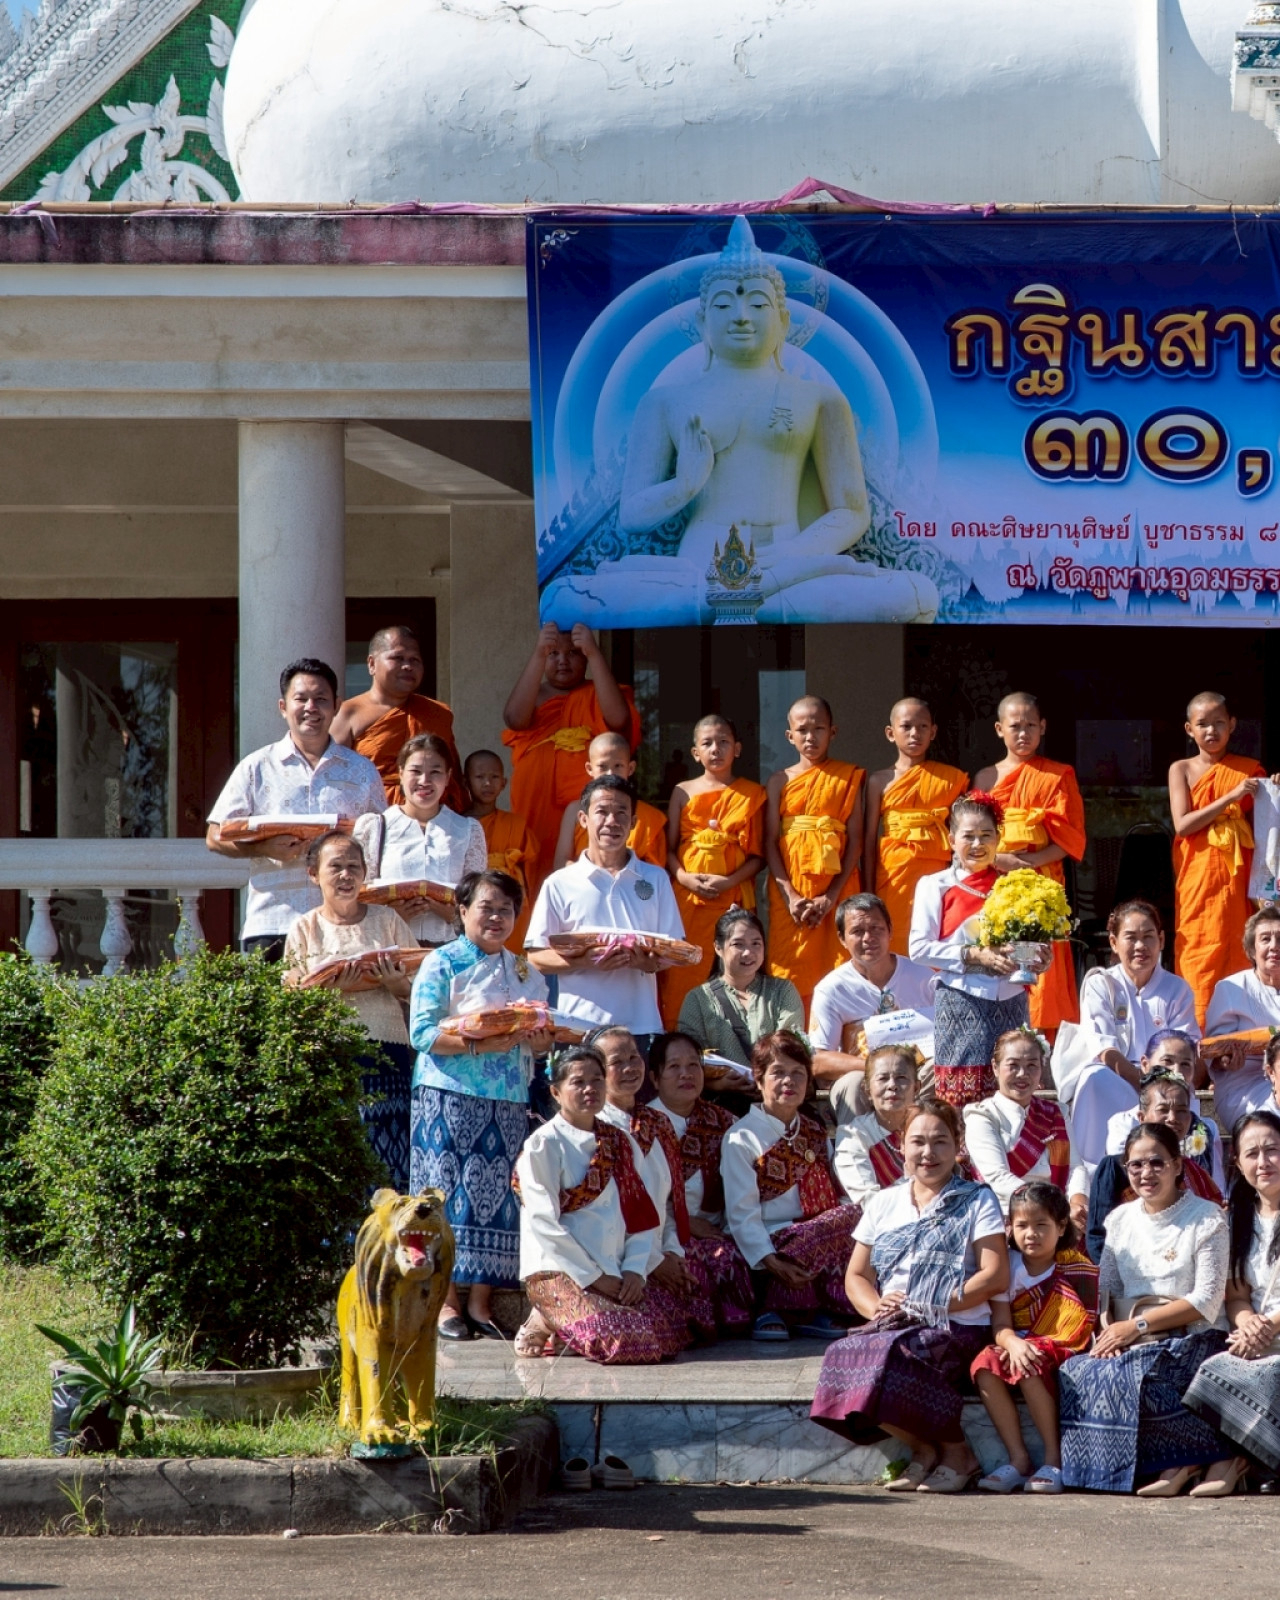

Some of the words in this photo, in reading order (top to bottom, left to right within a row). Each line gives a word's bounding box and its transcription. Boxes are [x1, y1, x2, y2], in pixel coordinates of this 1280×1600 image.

[894, 511, 937, 538] โดย
[951, 514, 1131, 549] คณะศิษยานุศิษย์
[1144, 520, 1245, 549] บูชาธรรม
[1007, 563, 1037, 589] ณ
